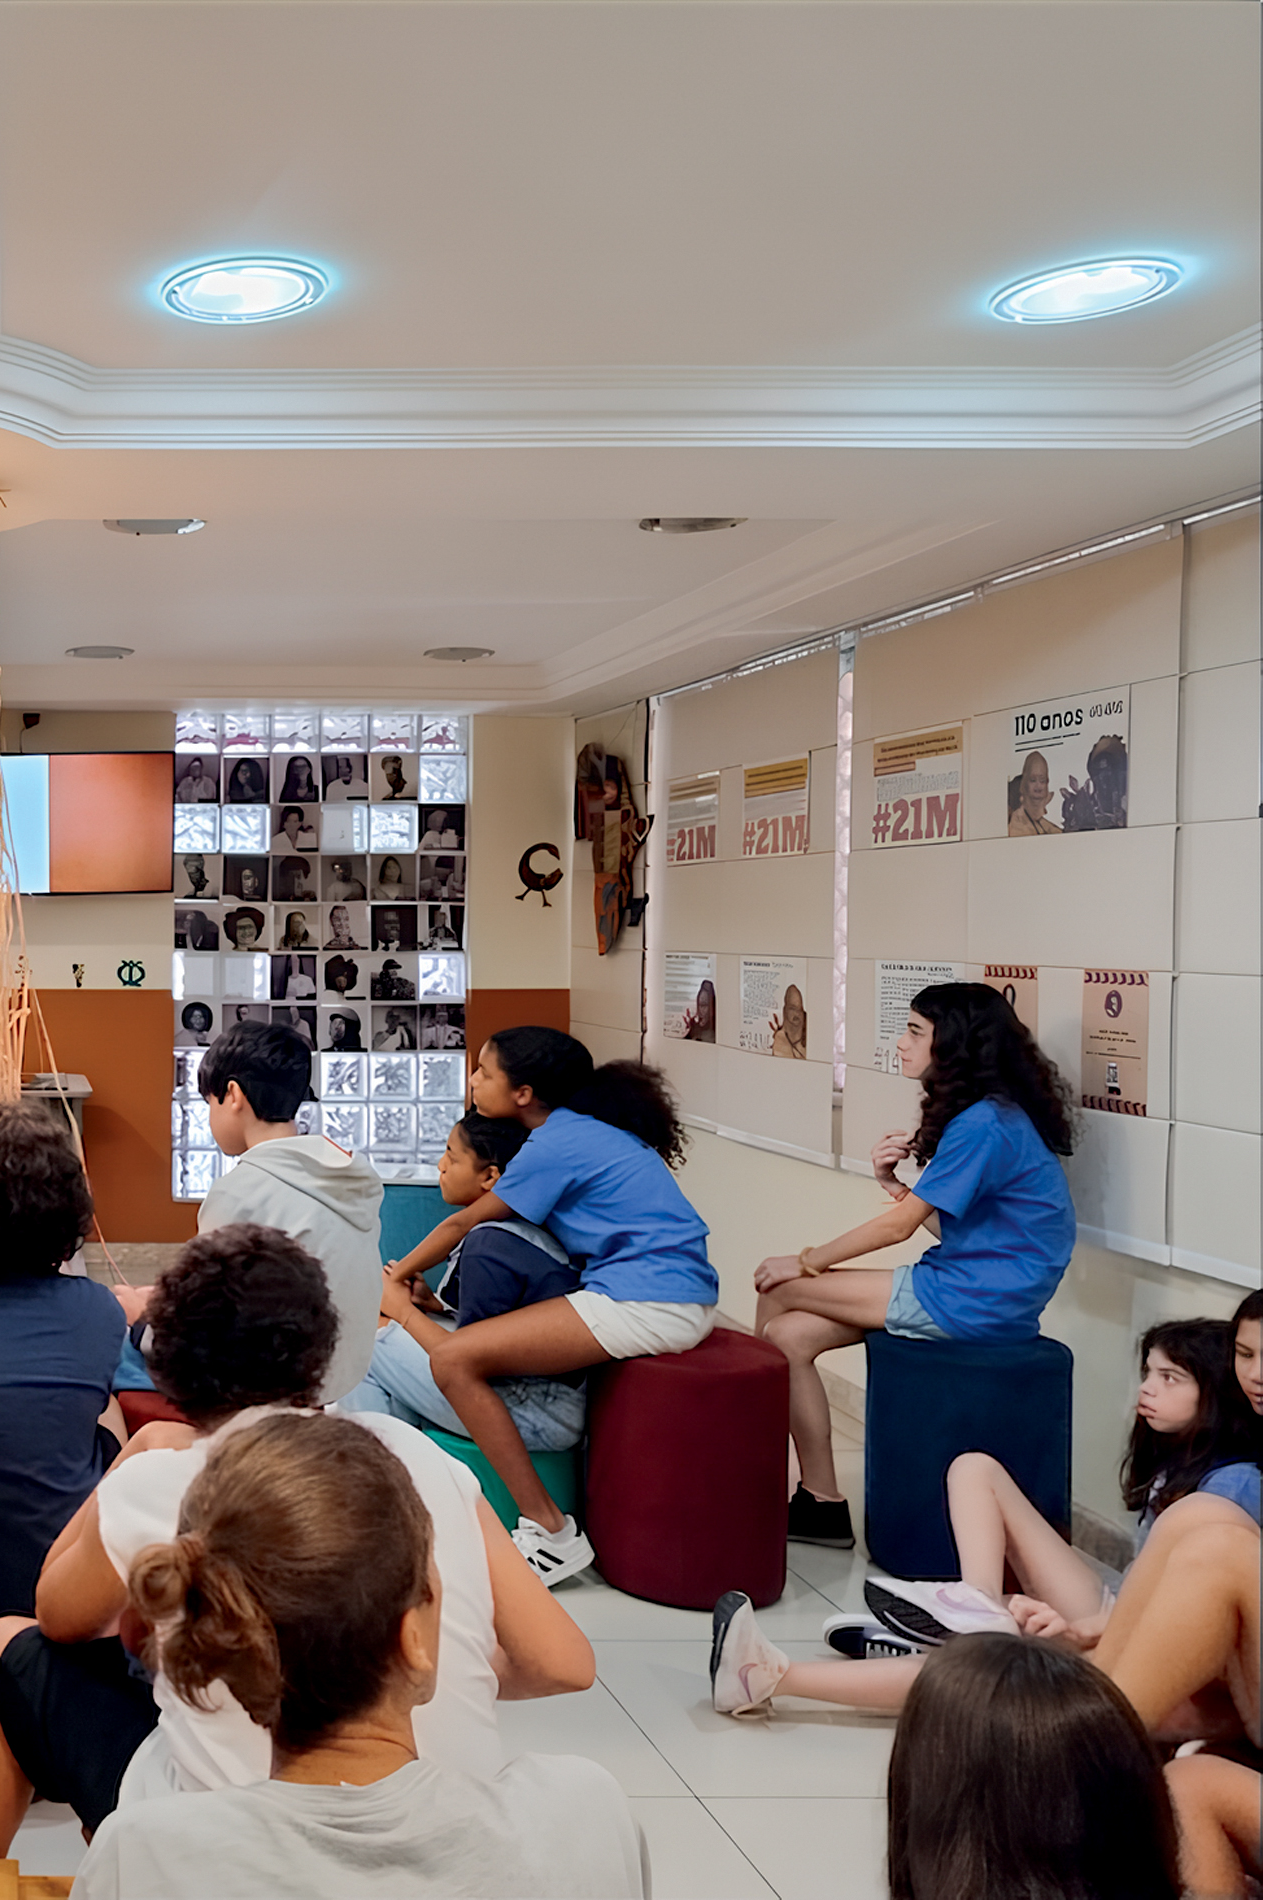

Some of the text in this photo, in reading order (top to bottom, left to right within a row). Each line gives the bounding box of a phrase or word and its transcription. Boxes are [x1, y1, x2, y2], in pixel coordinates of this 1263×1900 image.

[1015, 713, 1036, 736] 110
[1040, 708, 1083, 731] anos
[743, 815, 806, 855] #21M
[872, 793, 959, 844] #21M
